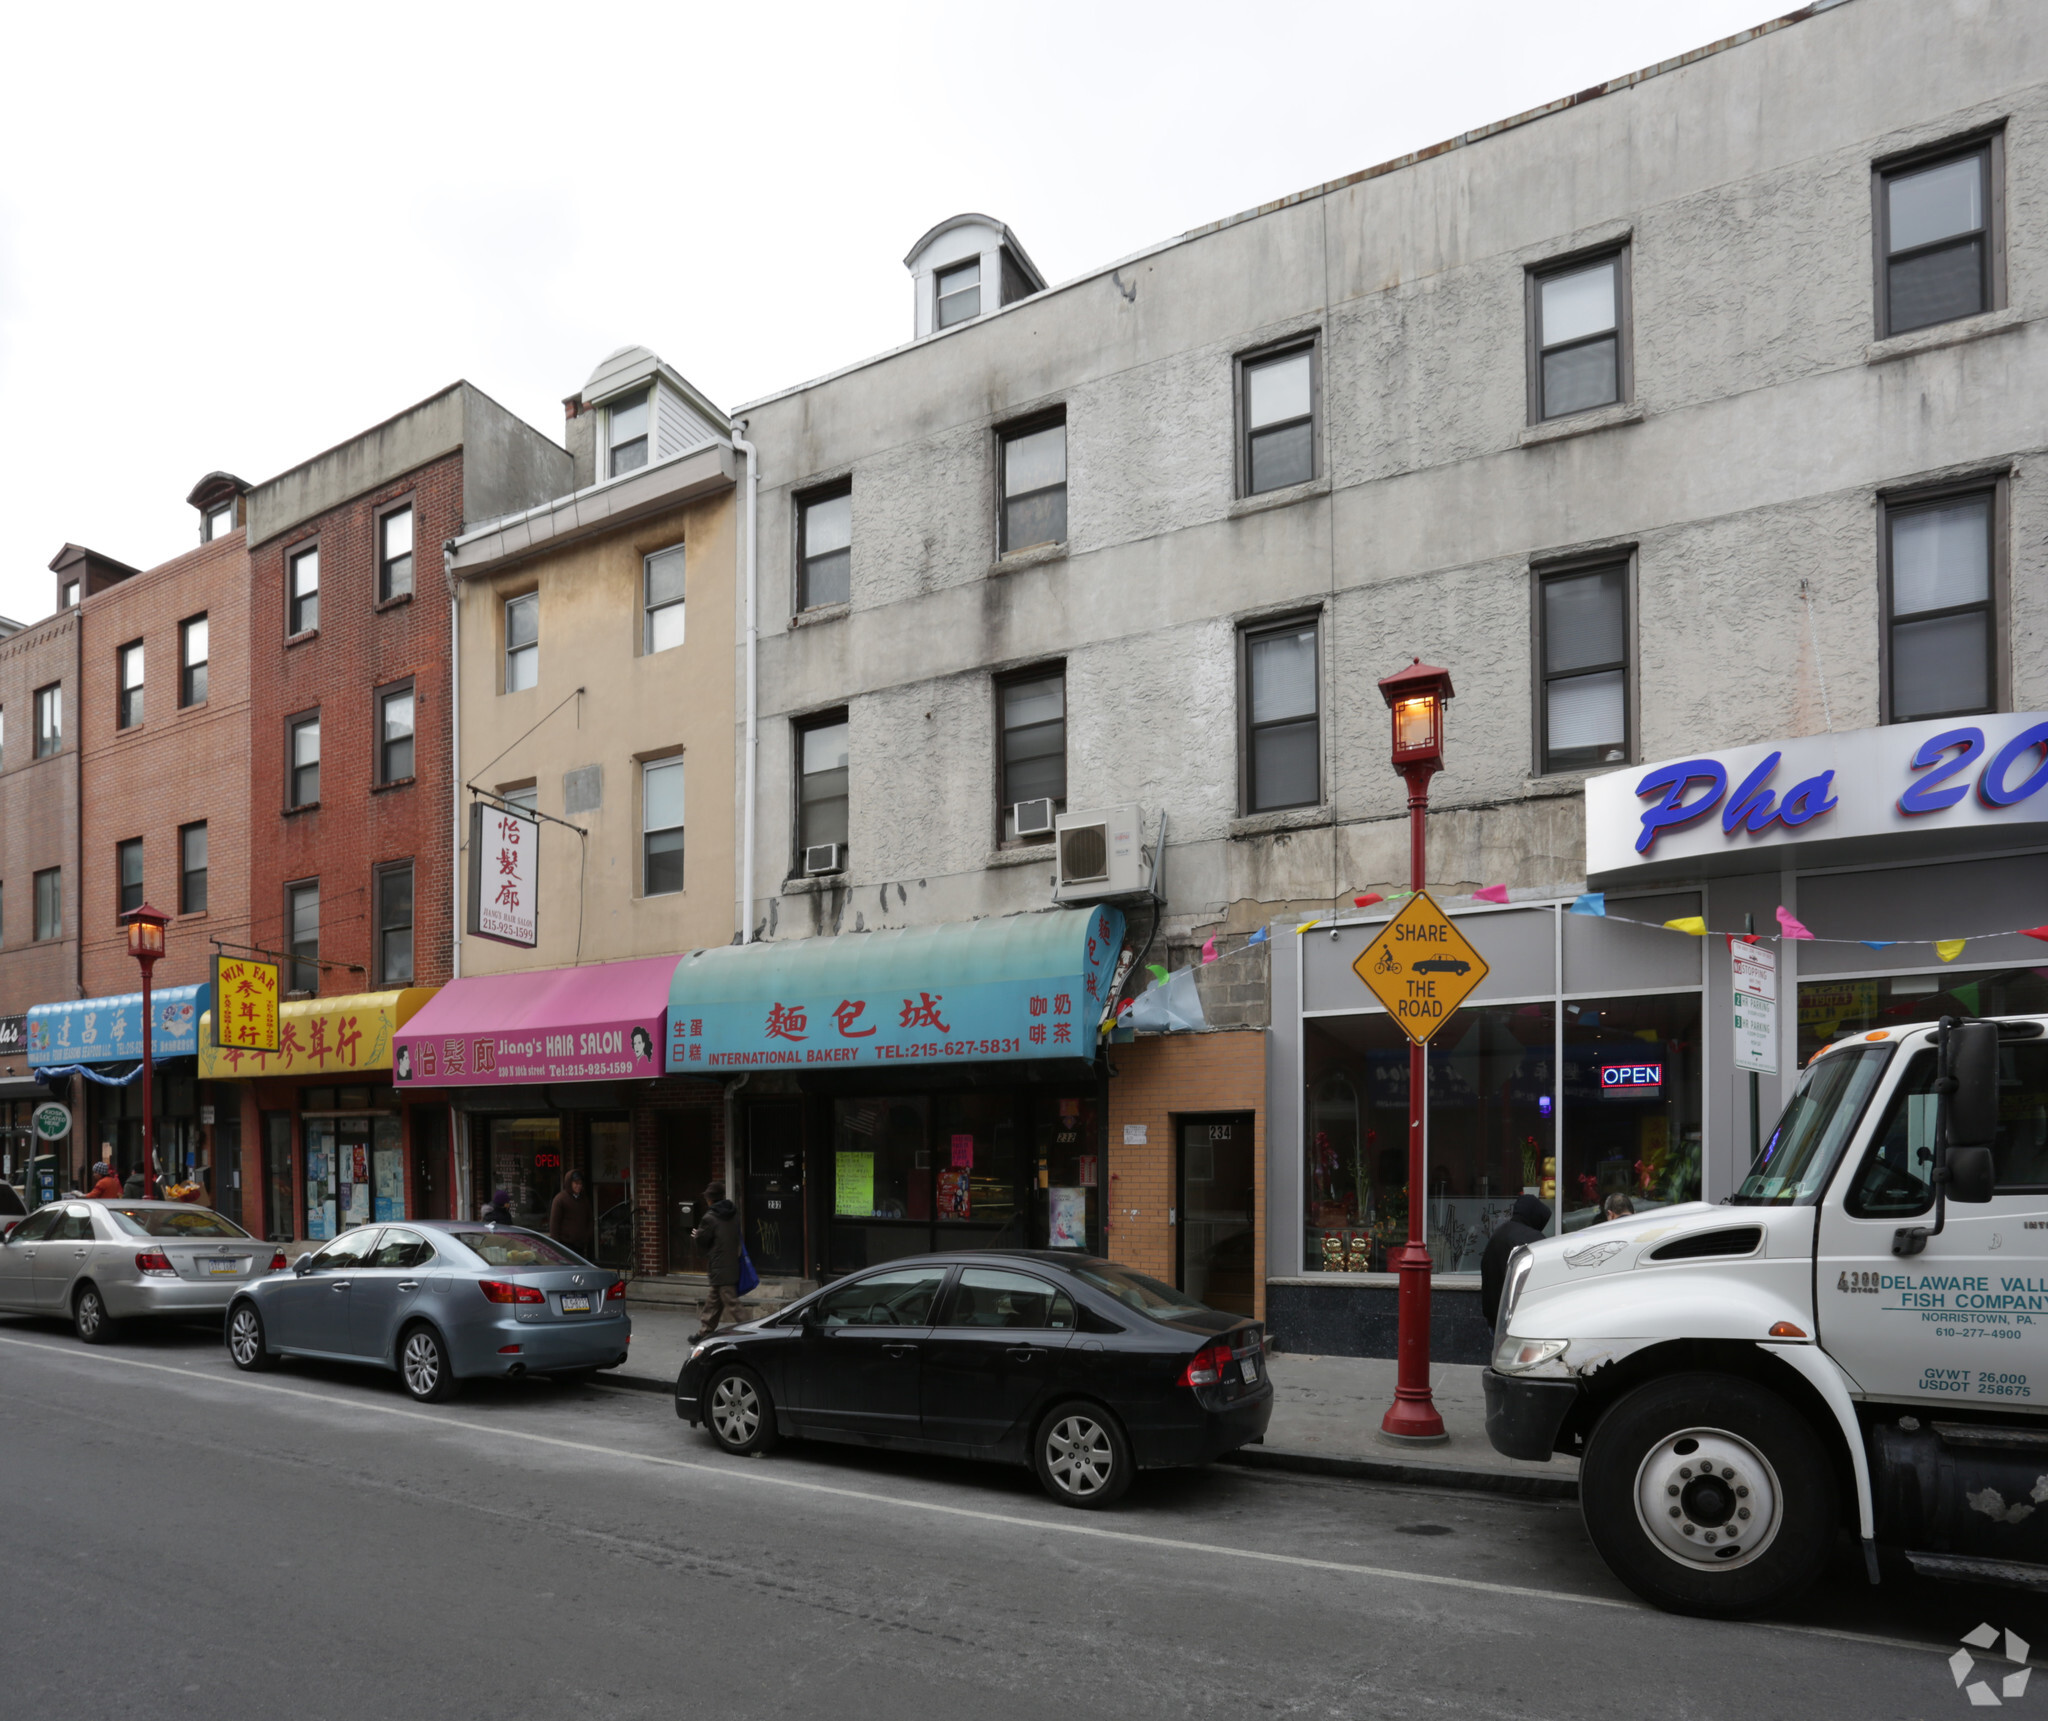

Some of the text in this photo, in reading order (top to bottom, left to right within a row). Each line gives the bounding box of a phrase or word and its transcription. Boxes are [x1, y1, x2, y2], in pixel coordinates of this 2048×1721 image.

[483, 907, 533, 928] JIANG'S HAIR SALON
[482, 918, 533, 940] 215-925-1599
[1396, 924, 1448, 942] SHARE
[220, 963, 275, 992] WIN FAR
[1742, 964, 1767, 981] STOPPING
[1406, 980, 1436, 998] THE
[1398, 1000, 1442, 1018] ROAD
[1750, 999, 1770, 1012] PARKING
[764, 992, 951, 1042] 麵包城
[1750, 1020, 1770, 1034] PARKING
[498, 1031, 622, 1058] Jiang's HAIR SALON
[708, 1037, 1020, 1066] INTERNATIONAL BAKERY TEL:215-627-5831
[510, 1066, 514, 1076] N
[528, 1064, 545, 1076] street
[550, 1061, 632, 1077] Tel:215-925-1599
[1604, 1067, 1659, 1084] OPEN
[40, 1114, 66, 1122] LOCATED
[1210, 1126, 1230, 1139] 234
[535, 1154, 560, 1168] OPEN
[768, 1200, 782, 1209] 232
[1837, 1271, 1879, 1292] 4300
[1881, 1276, 1988, 1291] DELAWARE
[1902, 1293, 1944, 1308] FISH
[1922, 1312, 2036, 1326] NORRISTOWN, PA.
[1936, 1328, 2021, 1340] 610-277-4900
[1924, 1368, 2026, 1386] GVWT 26,000
[1919, 1380, 2030, 1397] USDOT 258675
